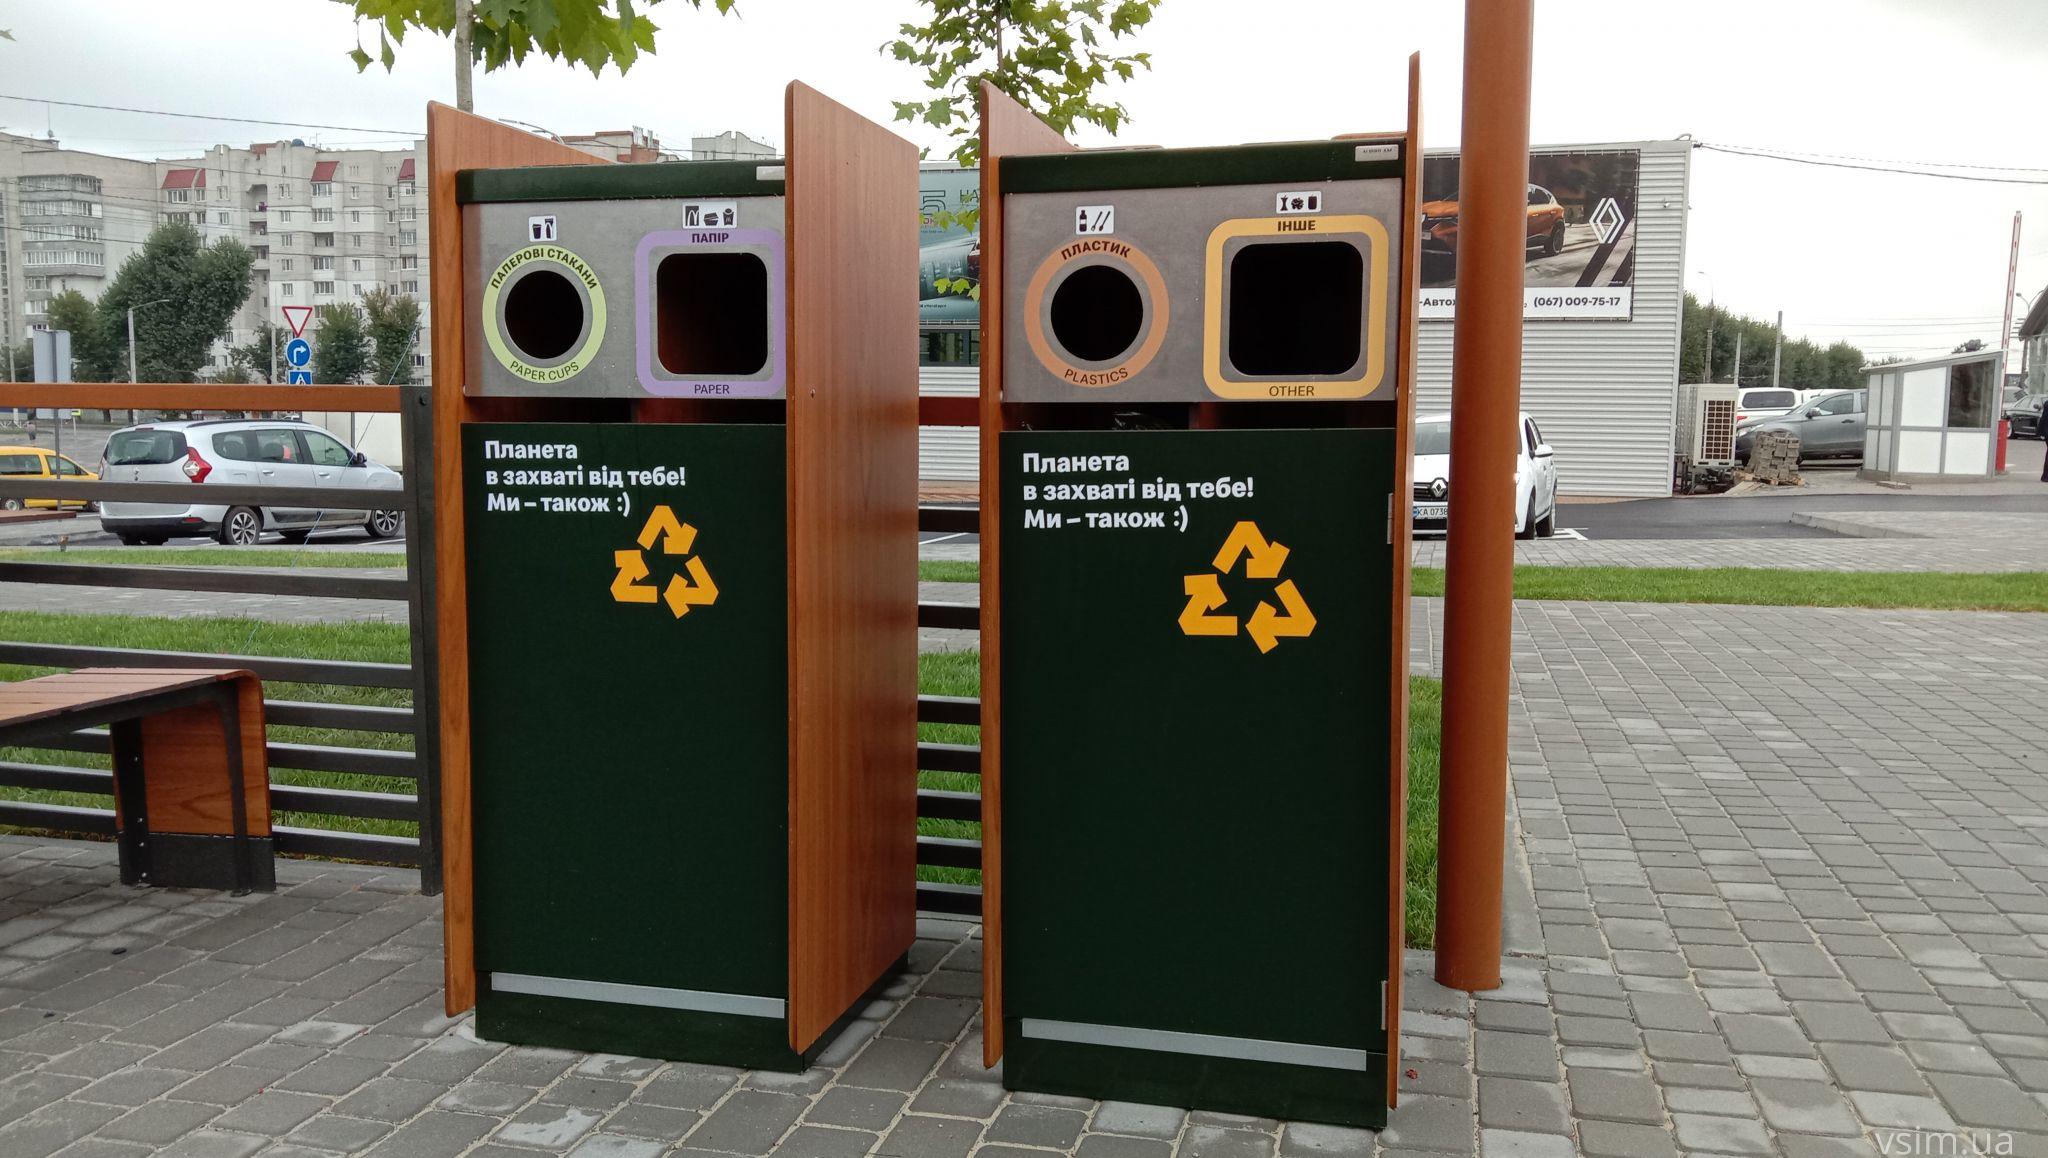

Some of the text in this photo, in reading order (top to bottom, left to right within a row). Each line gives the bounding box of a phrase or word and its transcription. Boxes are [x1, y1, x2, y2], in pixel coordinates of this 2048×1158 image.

[1277, 220, 1316, 232] ІНШЕ
[691, 232, 729, 243] ПАПІР
[1061, 240, 1131, 260] ПЛАСТИК
[491, 248, 598, 289] ПАПЕРОВІ СТАКАНИ
[1533, 296, 1621, 308] (067) 009-75-17
[510, 360, 580, 381] PAPER CUPS
[1064, 367, 1128, 385] PLASTICS
[693, 383, 730, 395] PAPER
[1269, 384, 1315, 398] OTHER
[485, 440, 578, 460] Планета
[1023, 452, 1130, 474] Планета
[486, 465, 686, 489] в захваті від тебе!
[1023, 476, 1255, 502] в захваті від тебе!
[487, 492, 520, 512] Ми
[540, 496, 610, 513] також
[1023, 509, 1062, 529] Ми
[1085, 511, 1166, 529] також
